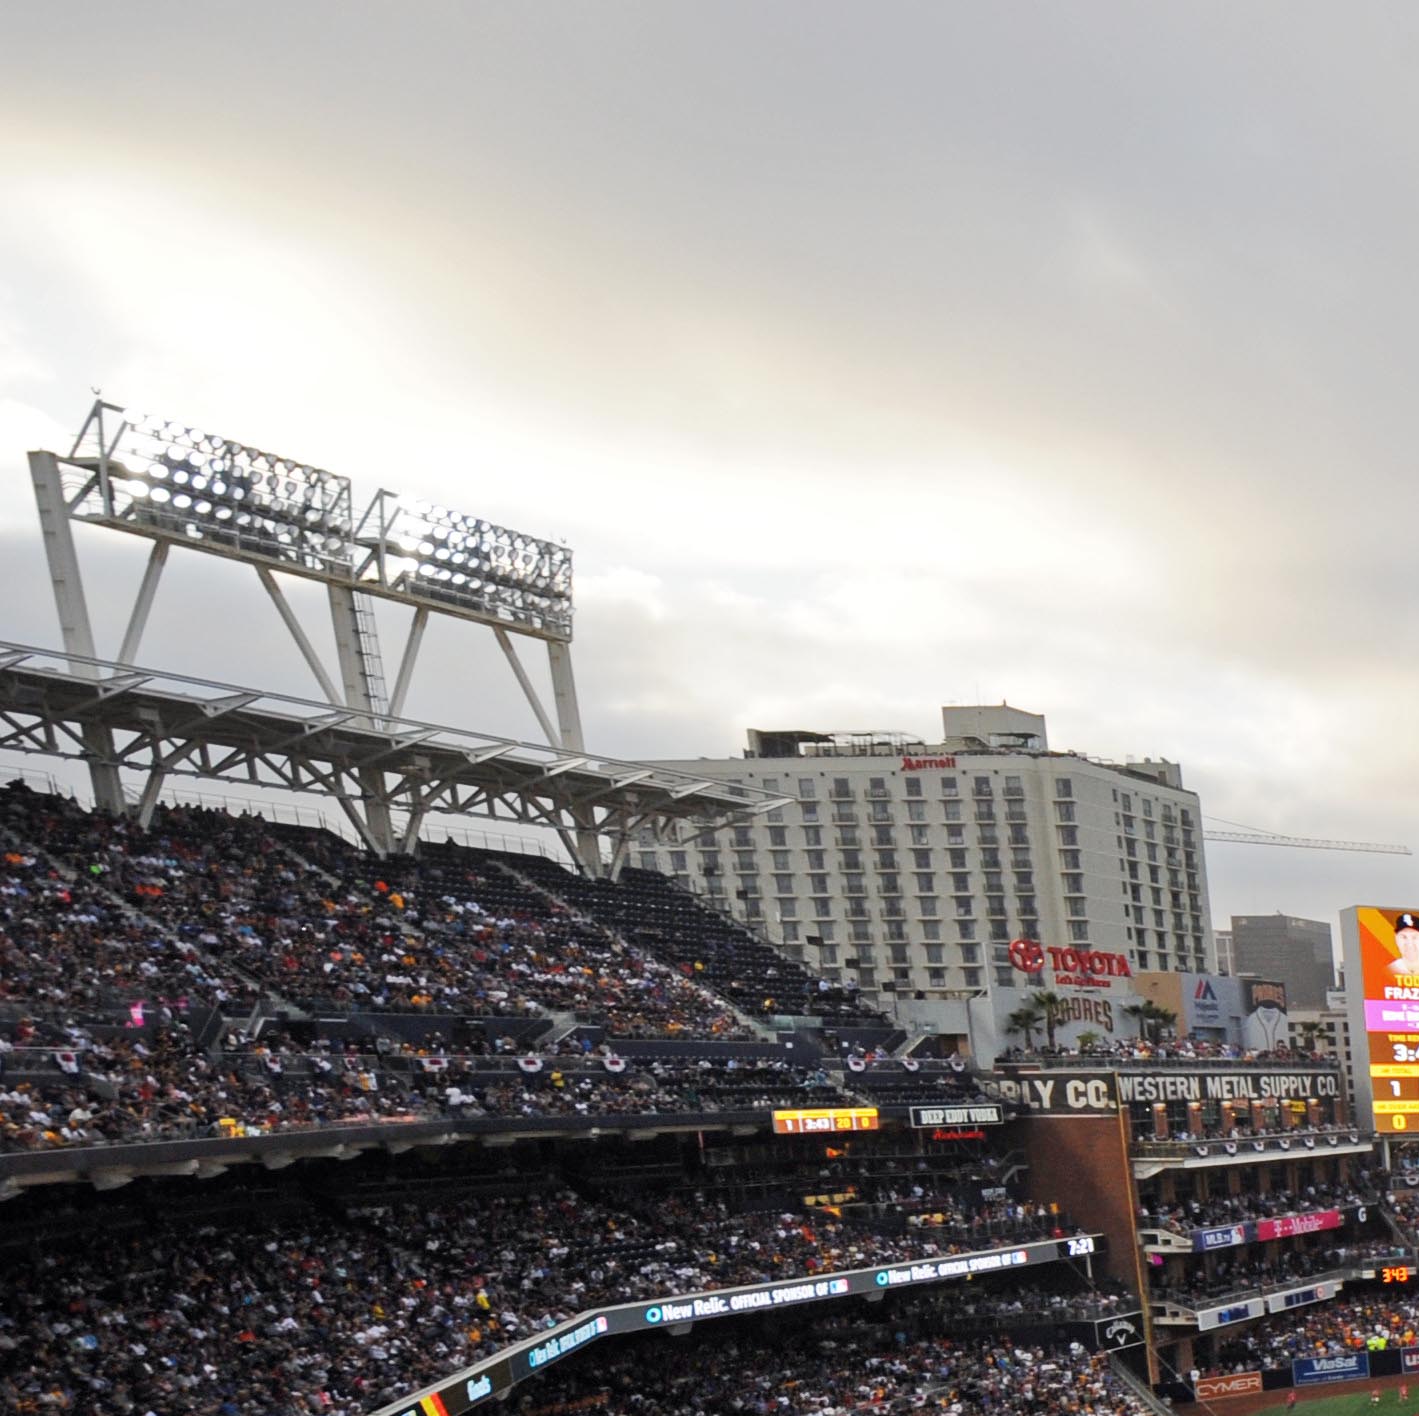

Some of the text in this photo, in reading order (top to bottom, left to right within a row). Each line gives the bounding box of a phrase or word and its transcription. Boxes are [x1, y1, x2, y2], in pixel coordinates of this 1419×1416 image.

[1048, 946, 1131, 977] TOYOTA
[1066, 1082, 1117, 1110] CO.
[1119, 1075, 1339, 1101] WESTERN METAL SUPPLY CO.
[1389, 1080, 1401, 1097] 1
[1392, 1114, 1406, 1130] 0
[1067, 1238, 1094, 1256] 7:21
[888, 1268, 911, 1285] New
[938, 1260, 968, 1278] OFFICIAL
[969, 1256, 999, 1273] SPONSOR
[662, 1301, 692, 1321] New
[730, 1291, 771, 1312] OFFICIAL
[771, 1286, 815, 1306] SPONSOR
[1313, 1356, 1358, 1371] ViaSat
[1197, 1378, 1261, 1396] CYMER
